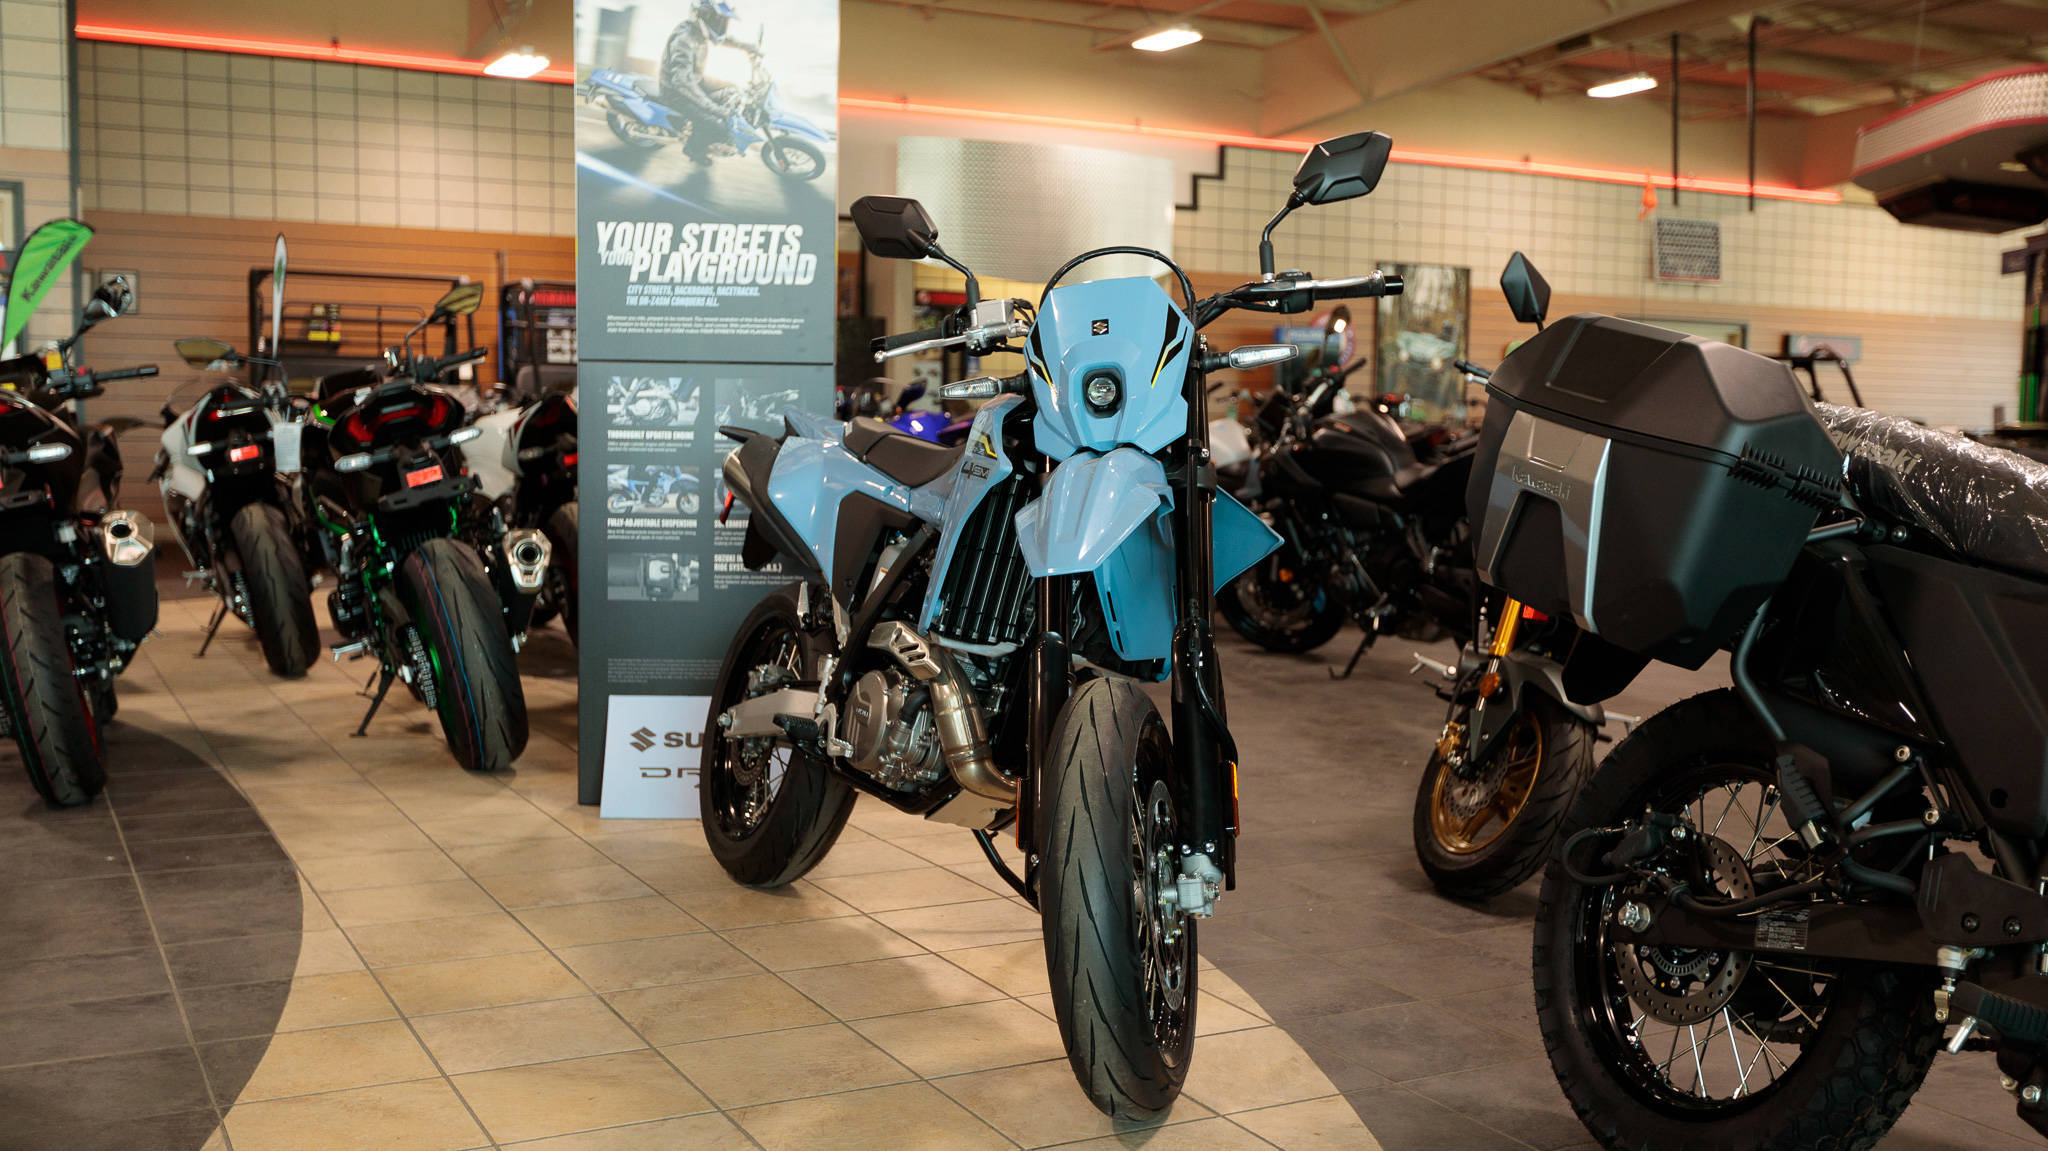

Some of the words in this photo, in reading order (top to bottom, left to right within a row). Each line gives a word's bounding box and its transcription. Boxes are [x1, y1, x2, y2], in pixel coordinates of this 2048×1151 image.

[596, 221, 674, 255] YOUR
[679, 223, 804, 257] STREETS
[21, 234, 78, 302] Kawasaki
[600, 251, 633, 266] YOUR
[629, 251, 818, 286] PLAYGROUND
[627, 285, 643, 295] CITY
[1831, 430, 1922, 475] awasaki
